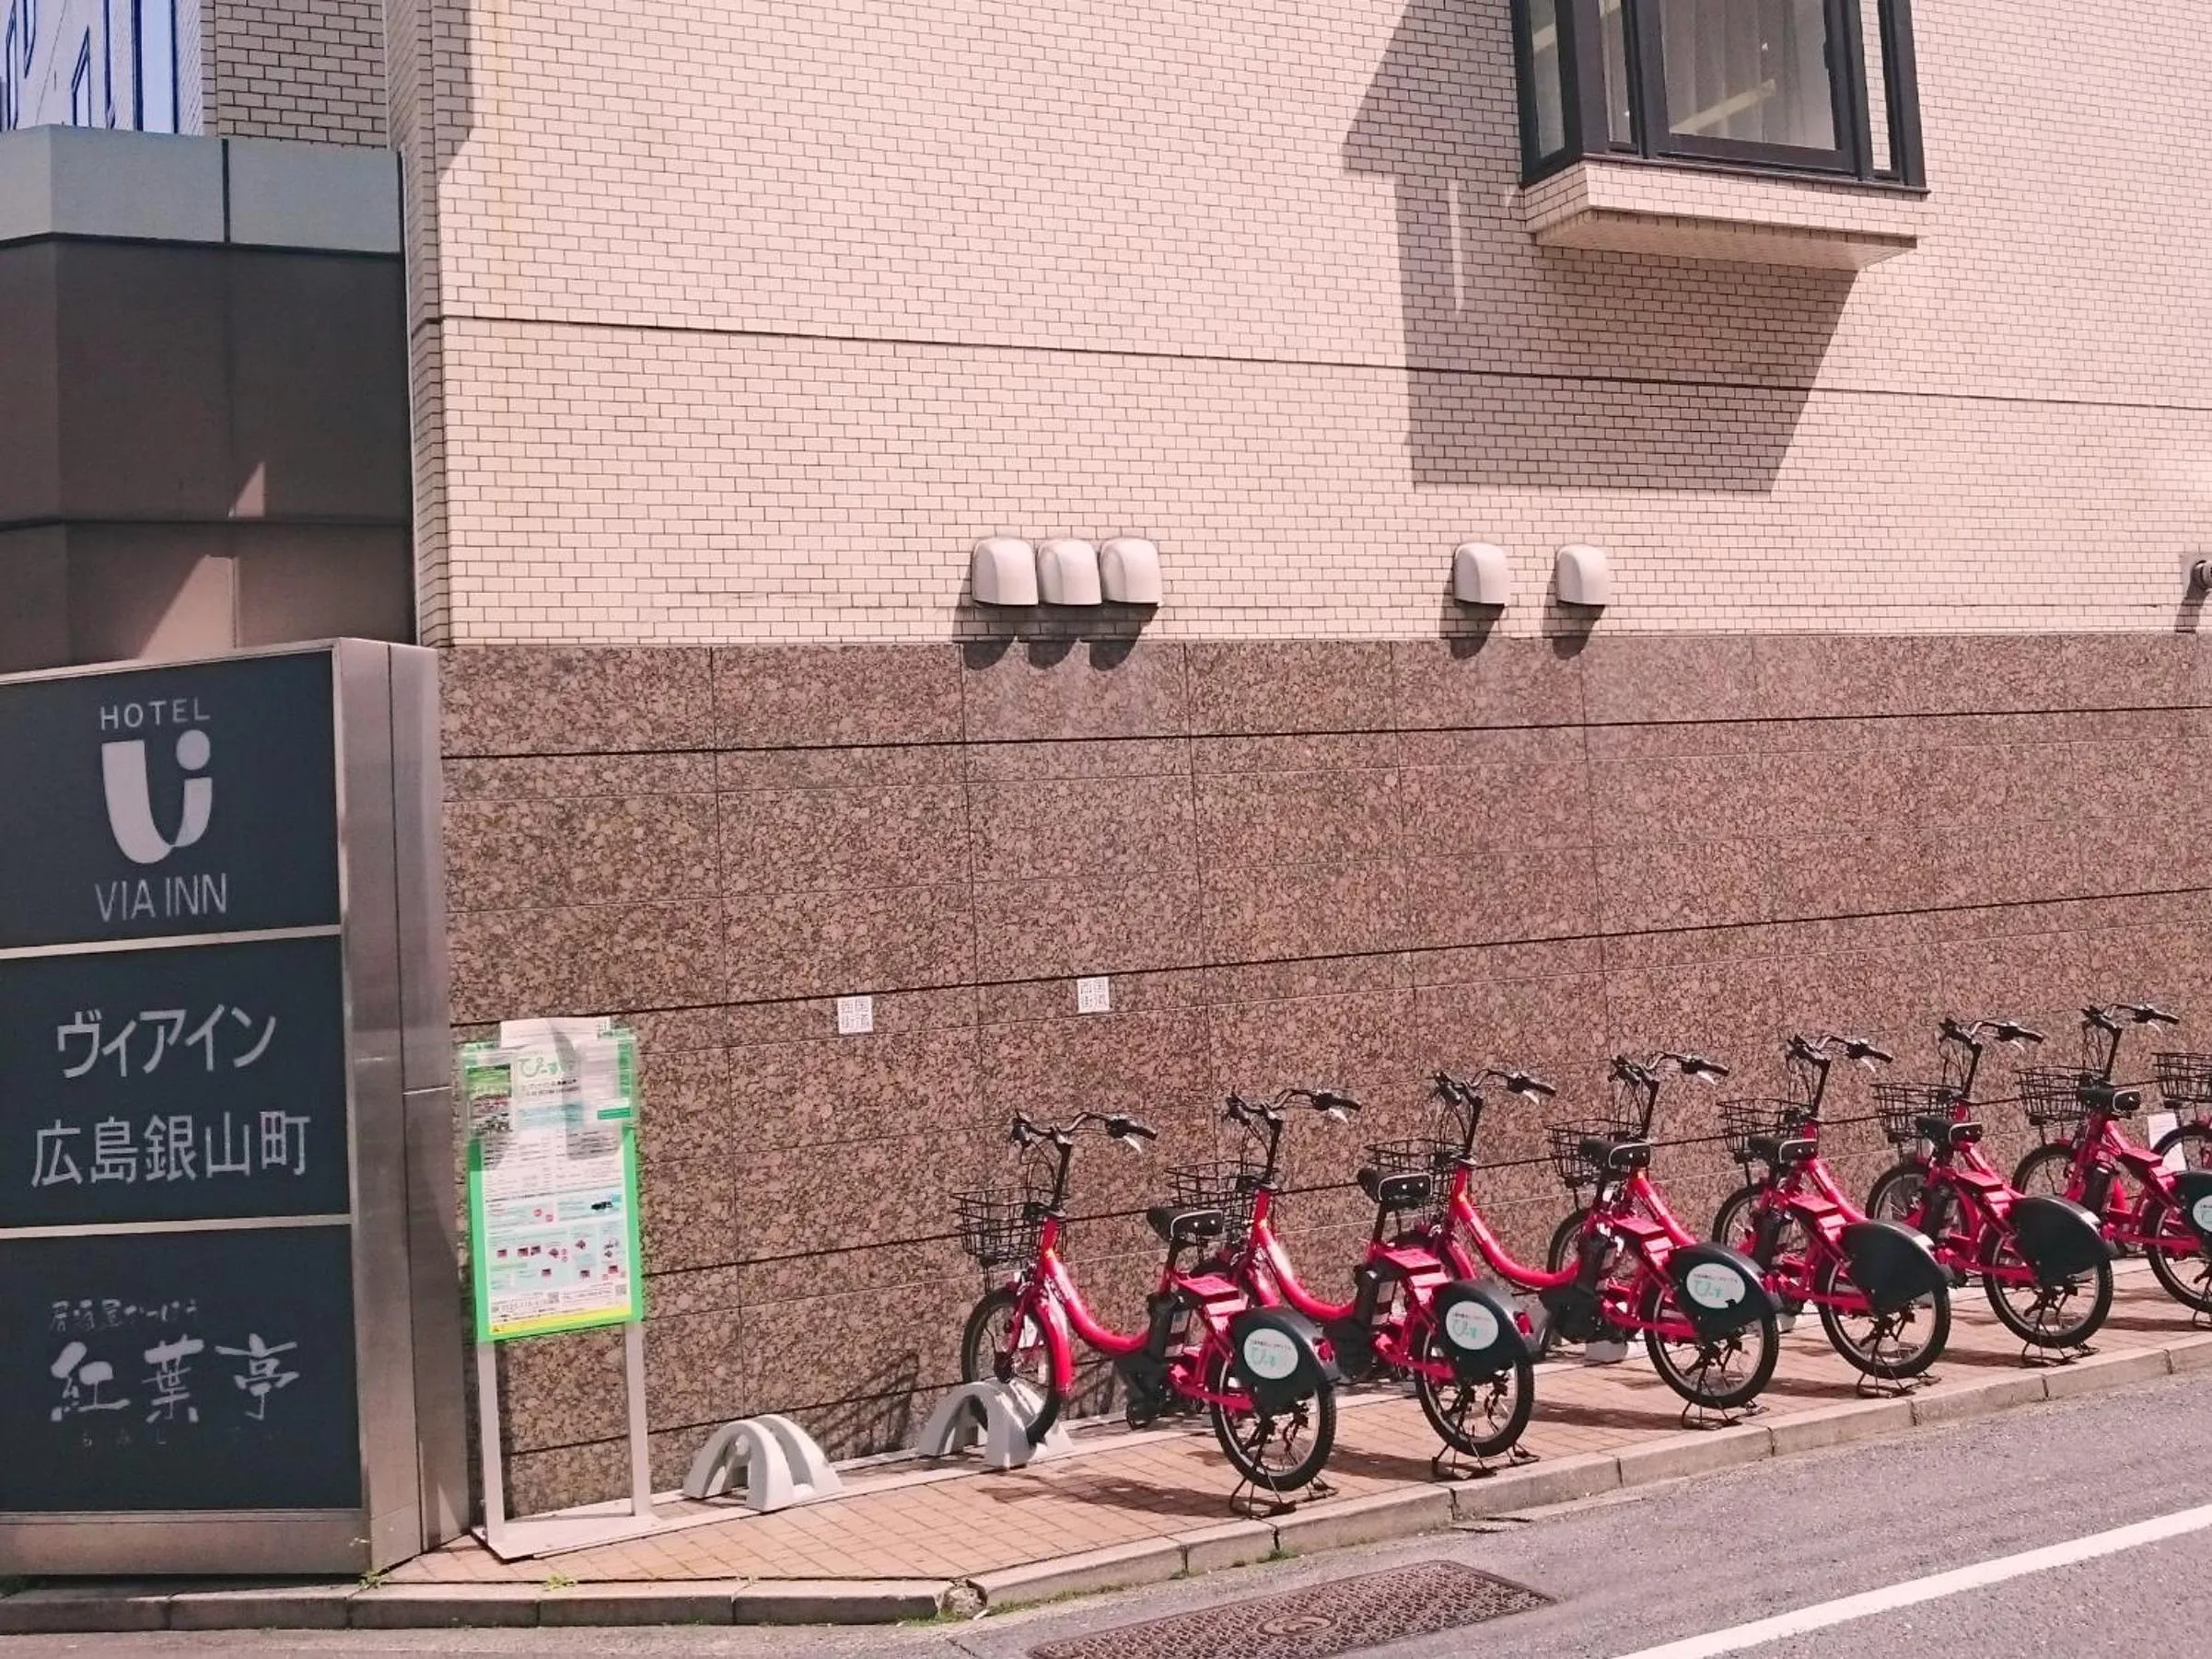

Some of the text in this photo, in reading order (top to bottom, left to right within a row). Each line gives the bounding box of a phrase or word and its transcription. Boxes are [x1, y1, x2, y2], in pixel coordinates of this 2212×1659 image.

[99, 697, 211, 730] HOTEL
[94, 872, 227, 922] VIA INN
[56, 1004, 277, 1078] ヴィアイン
[30, 1110, 311, 1188] 広島銀山町
[50, 1333, 300, 1422] 紅葉亭
